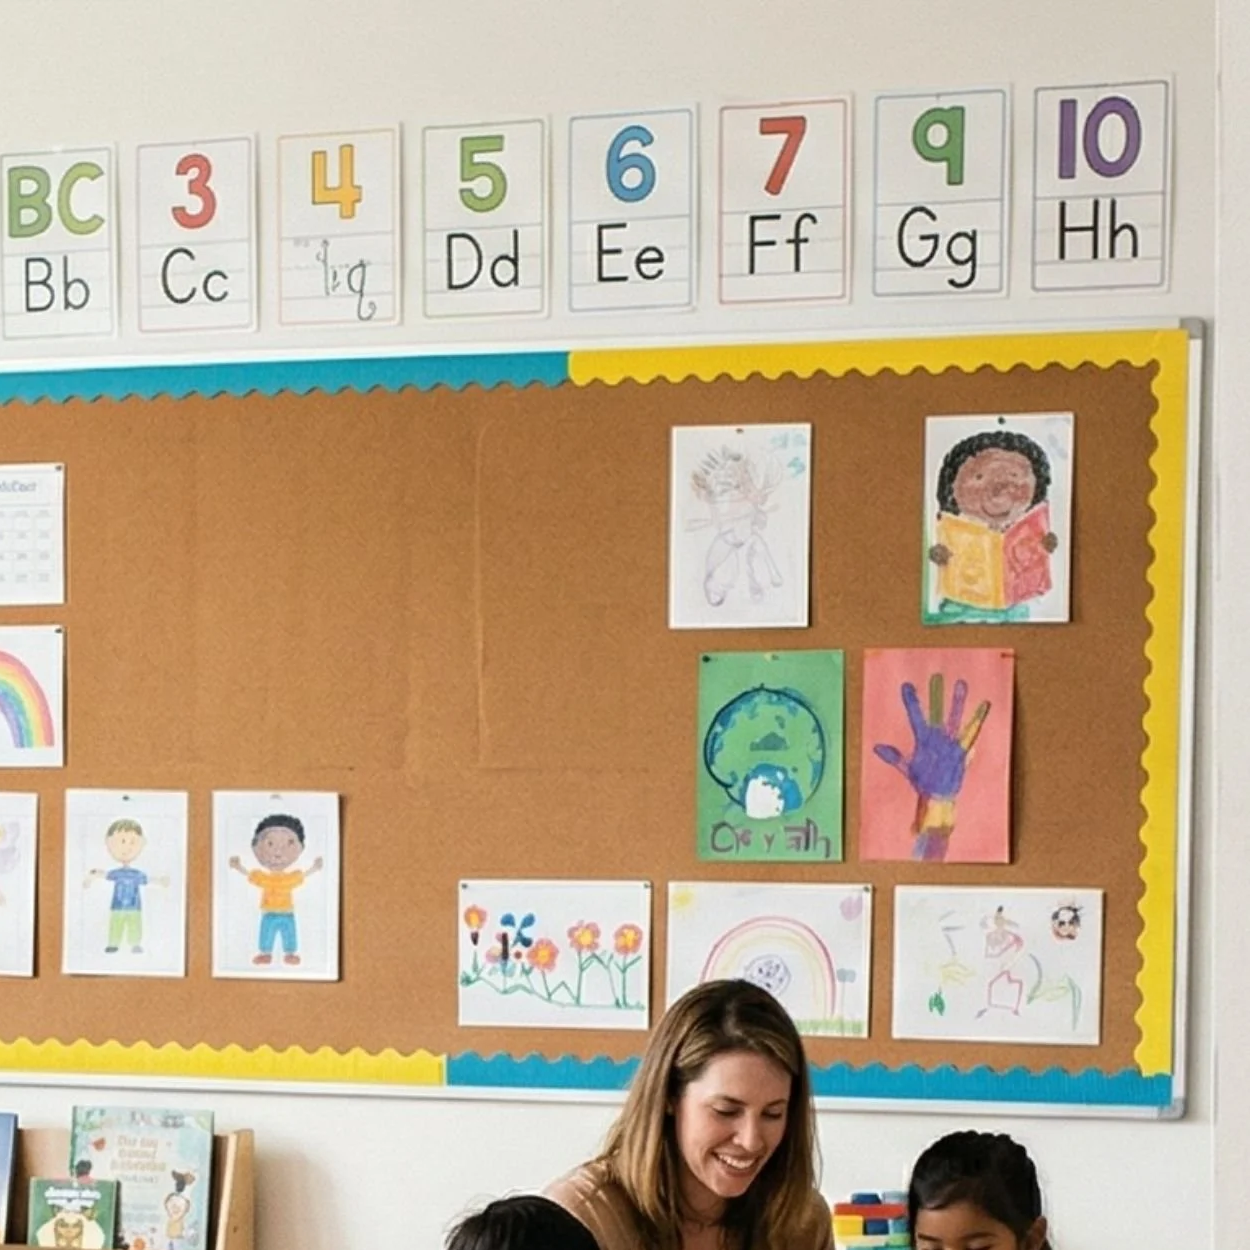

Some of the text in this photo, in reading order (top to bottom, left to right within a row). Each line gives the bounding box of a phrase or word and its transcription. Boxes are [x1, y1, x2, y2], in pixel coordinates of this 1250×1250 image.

[458, 134, 509, 214] 5
[605, 124, 657, 204] 6
[757, 115, 808, 197] 7
[1057, 95, 1143, 181] 10
[6, 161, 106, 239] BC
[170, 153, 218, 230] 3
[310, 143, 364, 220] 4
[445, 228, 521, 292] Dd
[595, 221, 666, 283] Ee
[747, 211, 819, 276] Ff
[896, 205, 979, 290] Gg
[1057, 197, 1140, 261] Hh
[23, 255, 92, 314] Bb
[160, 246, 230, 306] Cc
